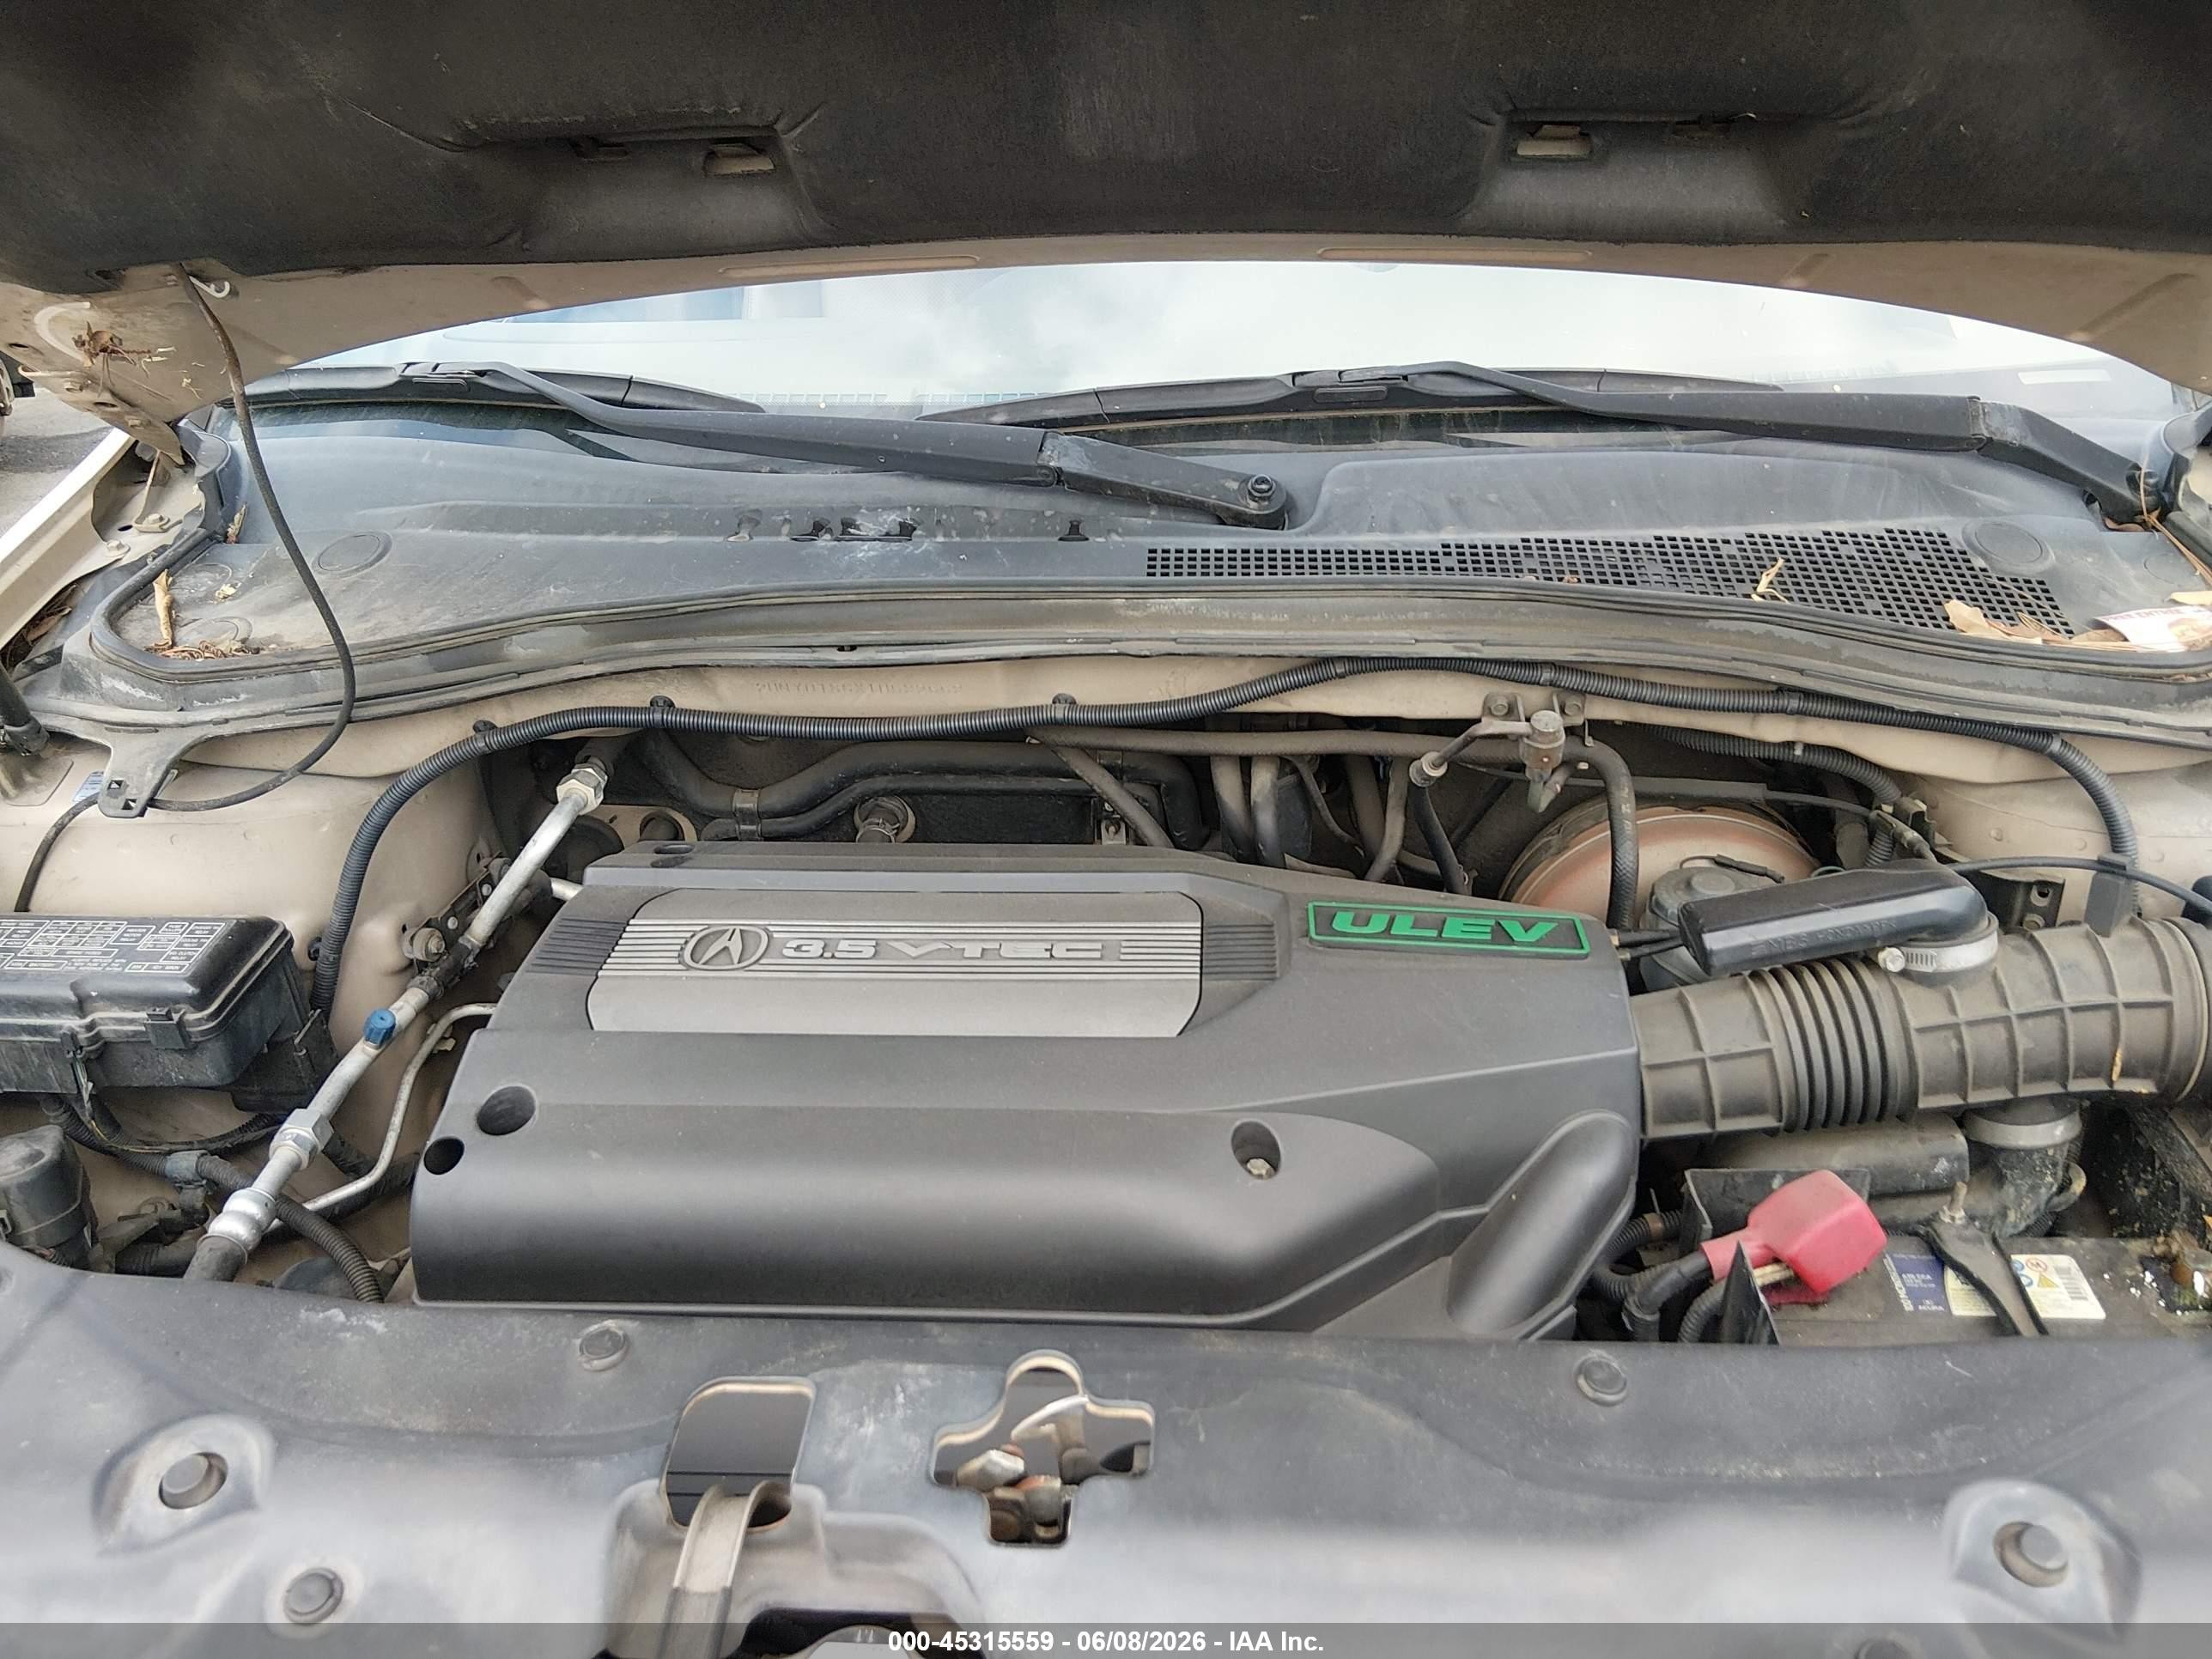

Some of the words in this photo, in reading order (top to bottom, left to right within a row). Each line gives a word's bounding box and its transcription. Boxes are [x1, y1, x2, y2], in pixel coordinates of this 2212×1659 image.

[1332, 910, 1559, 943] ULEV
[782, 939, 877, 959] 3.5
[886, 940, 1102, 960] VTEC
